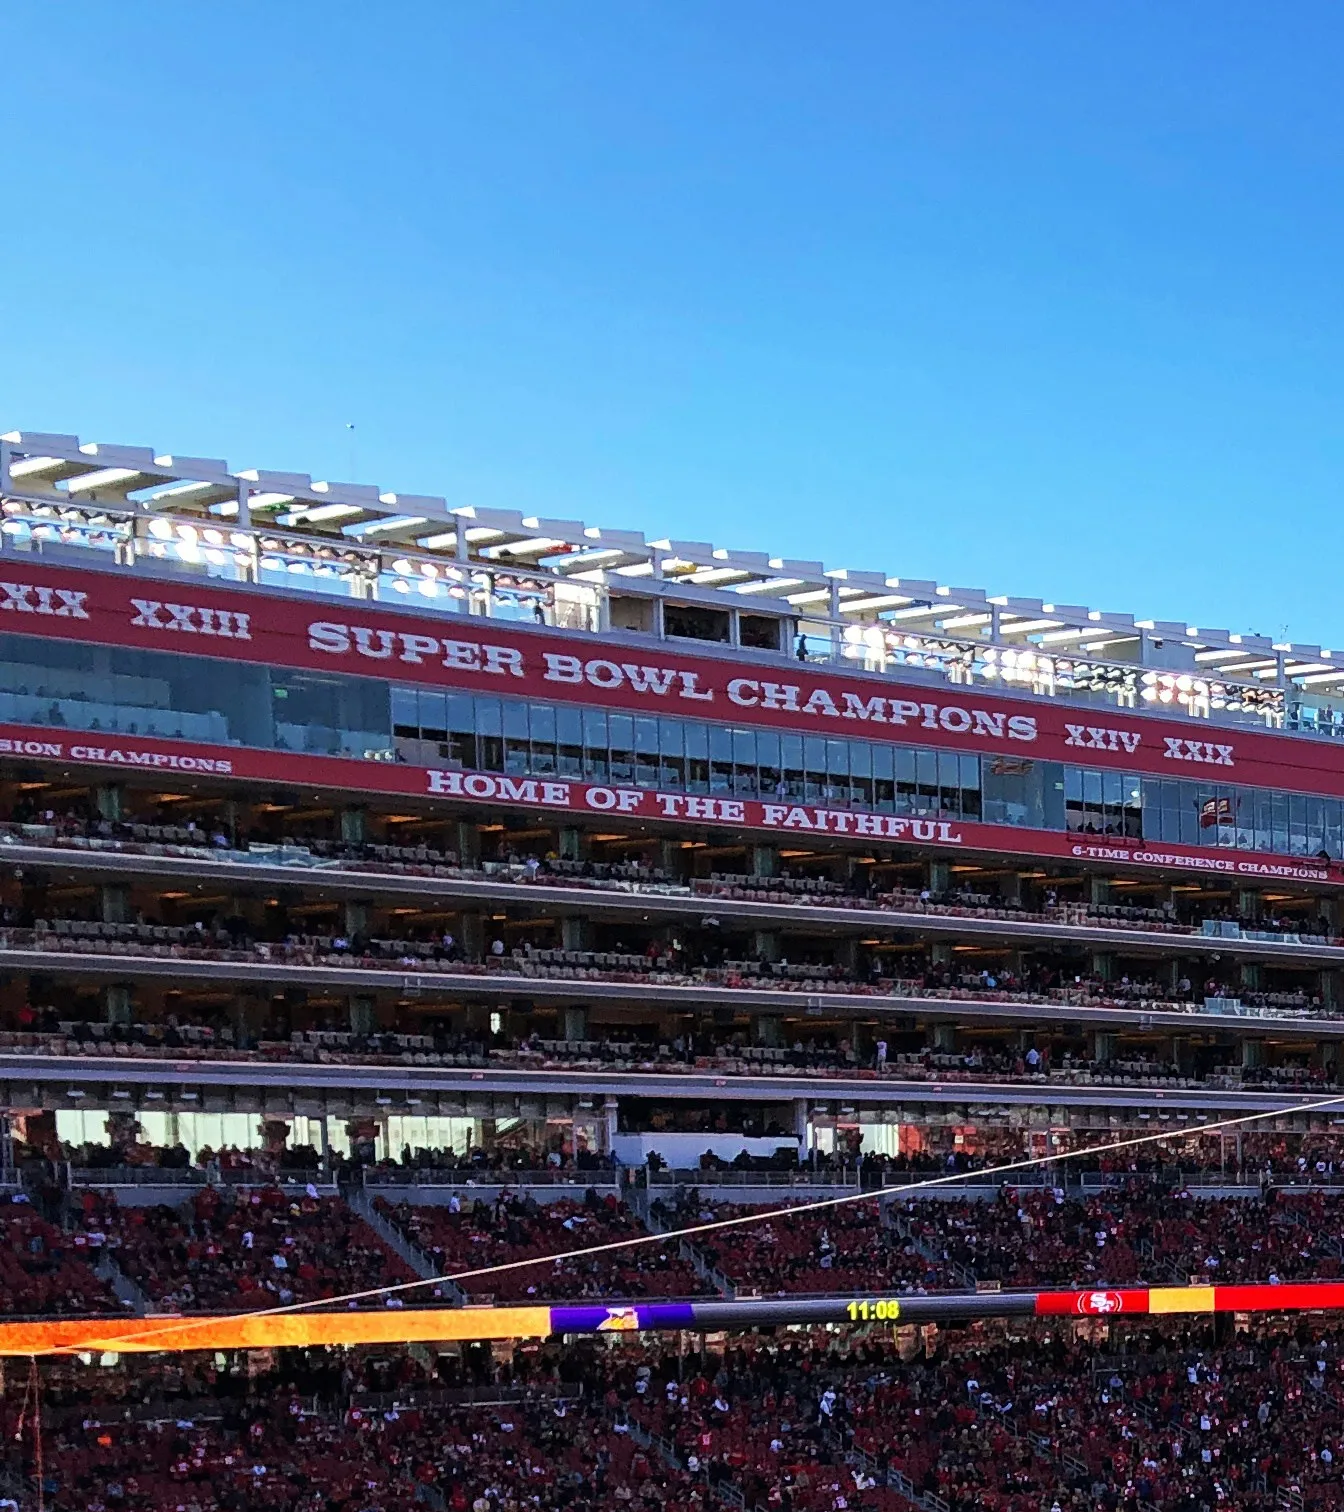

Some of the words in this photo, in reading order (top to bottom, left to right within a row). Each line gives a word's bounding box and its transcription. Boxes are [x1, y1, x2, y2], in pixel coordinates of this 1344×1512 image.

[130, 598, 252, 640] XXIII
[308, 621, 525, 677] SUPER
[542, 651, 713, 702] BOWL
[726, 677, 1039, 742] CHAMPIONS
[1064, 723, 1143, 753] XXIV
[1163, 736, 1235, 766] XXIX
[71, 745, 233, 774] CHAMPIONS
[427, 769, 571, 806] HOME
[586, 786, 644, 813] OF
[656, 792, 745, 823] THE
[762, 804, 962, 843] FAITHFUL
[1071, 845, 1130, 861] 6-TIME
[1133, 850, 1235, 873] CONFERENCE
[1238, 861, 1329, 881] CHAMPIONS
[847, 1299, 900, 1321] 11:08
